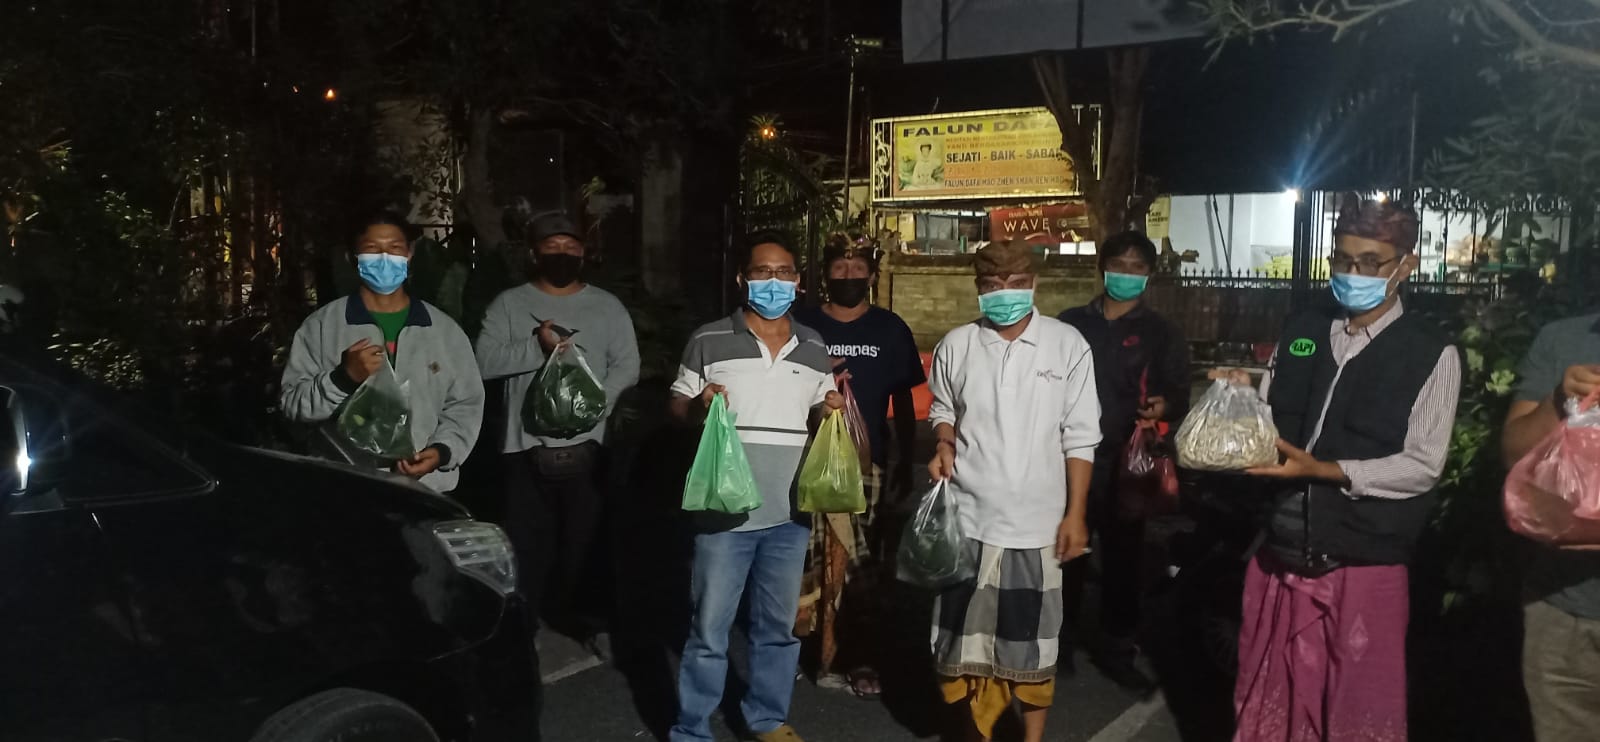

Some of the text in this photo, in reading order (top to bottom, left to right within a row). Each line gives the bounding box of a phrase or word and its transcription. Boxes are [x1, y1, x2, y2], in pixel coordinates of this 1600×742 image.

[902, 122, 984, 138] FALUN
[993, 117, 1059, 132] DAFA
[946, 152, 981, 163] SEJATI
[990, 150, 1016, 161] BAIK
[944, 179, 964, 188] FALUN
[965, 178, 981, 187] DAFA
[1003, 217, 1049, 232] WAVE
